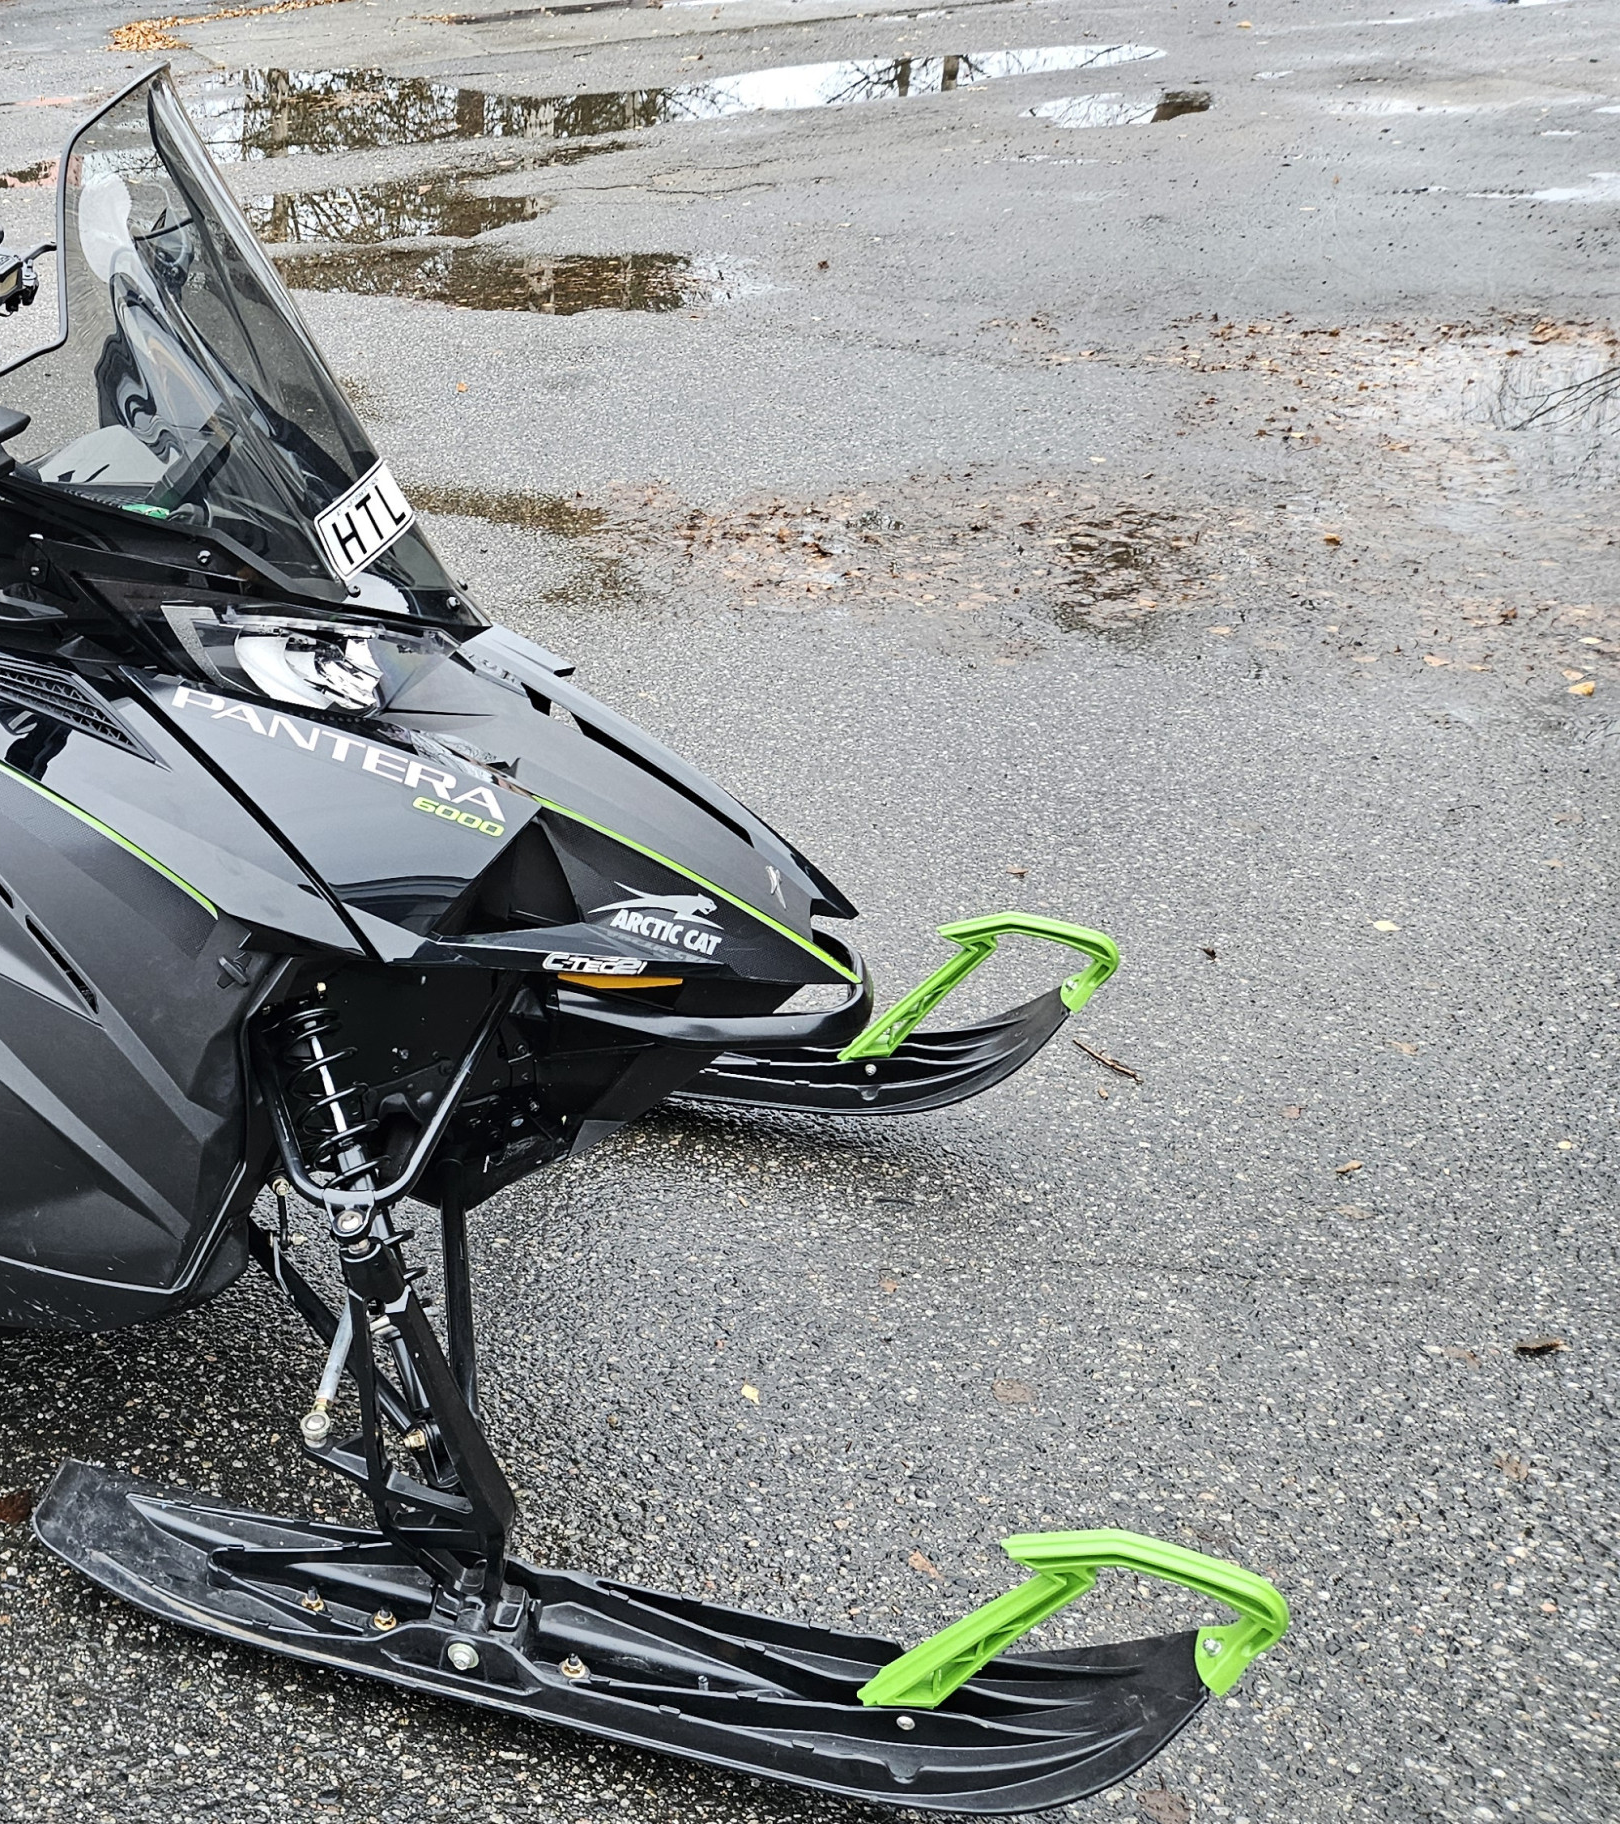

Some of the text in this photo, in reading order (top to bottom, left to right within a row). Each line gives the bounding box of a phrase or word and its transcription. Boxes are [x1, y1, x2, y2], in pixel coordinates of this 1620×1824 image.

[331, 485, 406, 565] HTL
[171, 685, 506, 823] PANTERA
[412, 796, 505, 837] 6000
[609, 908, 722, 955] ARCTIC CAT
